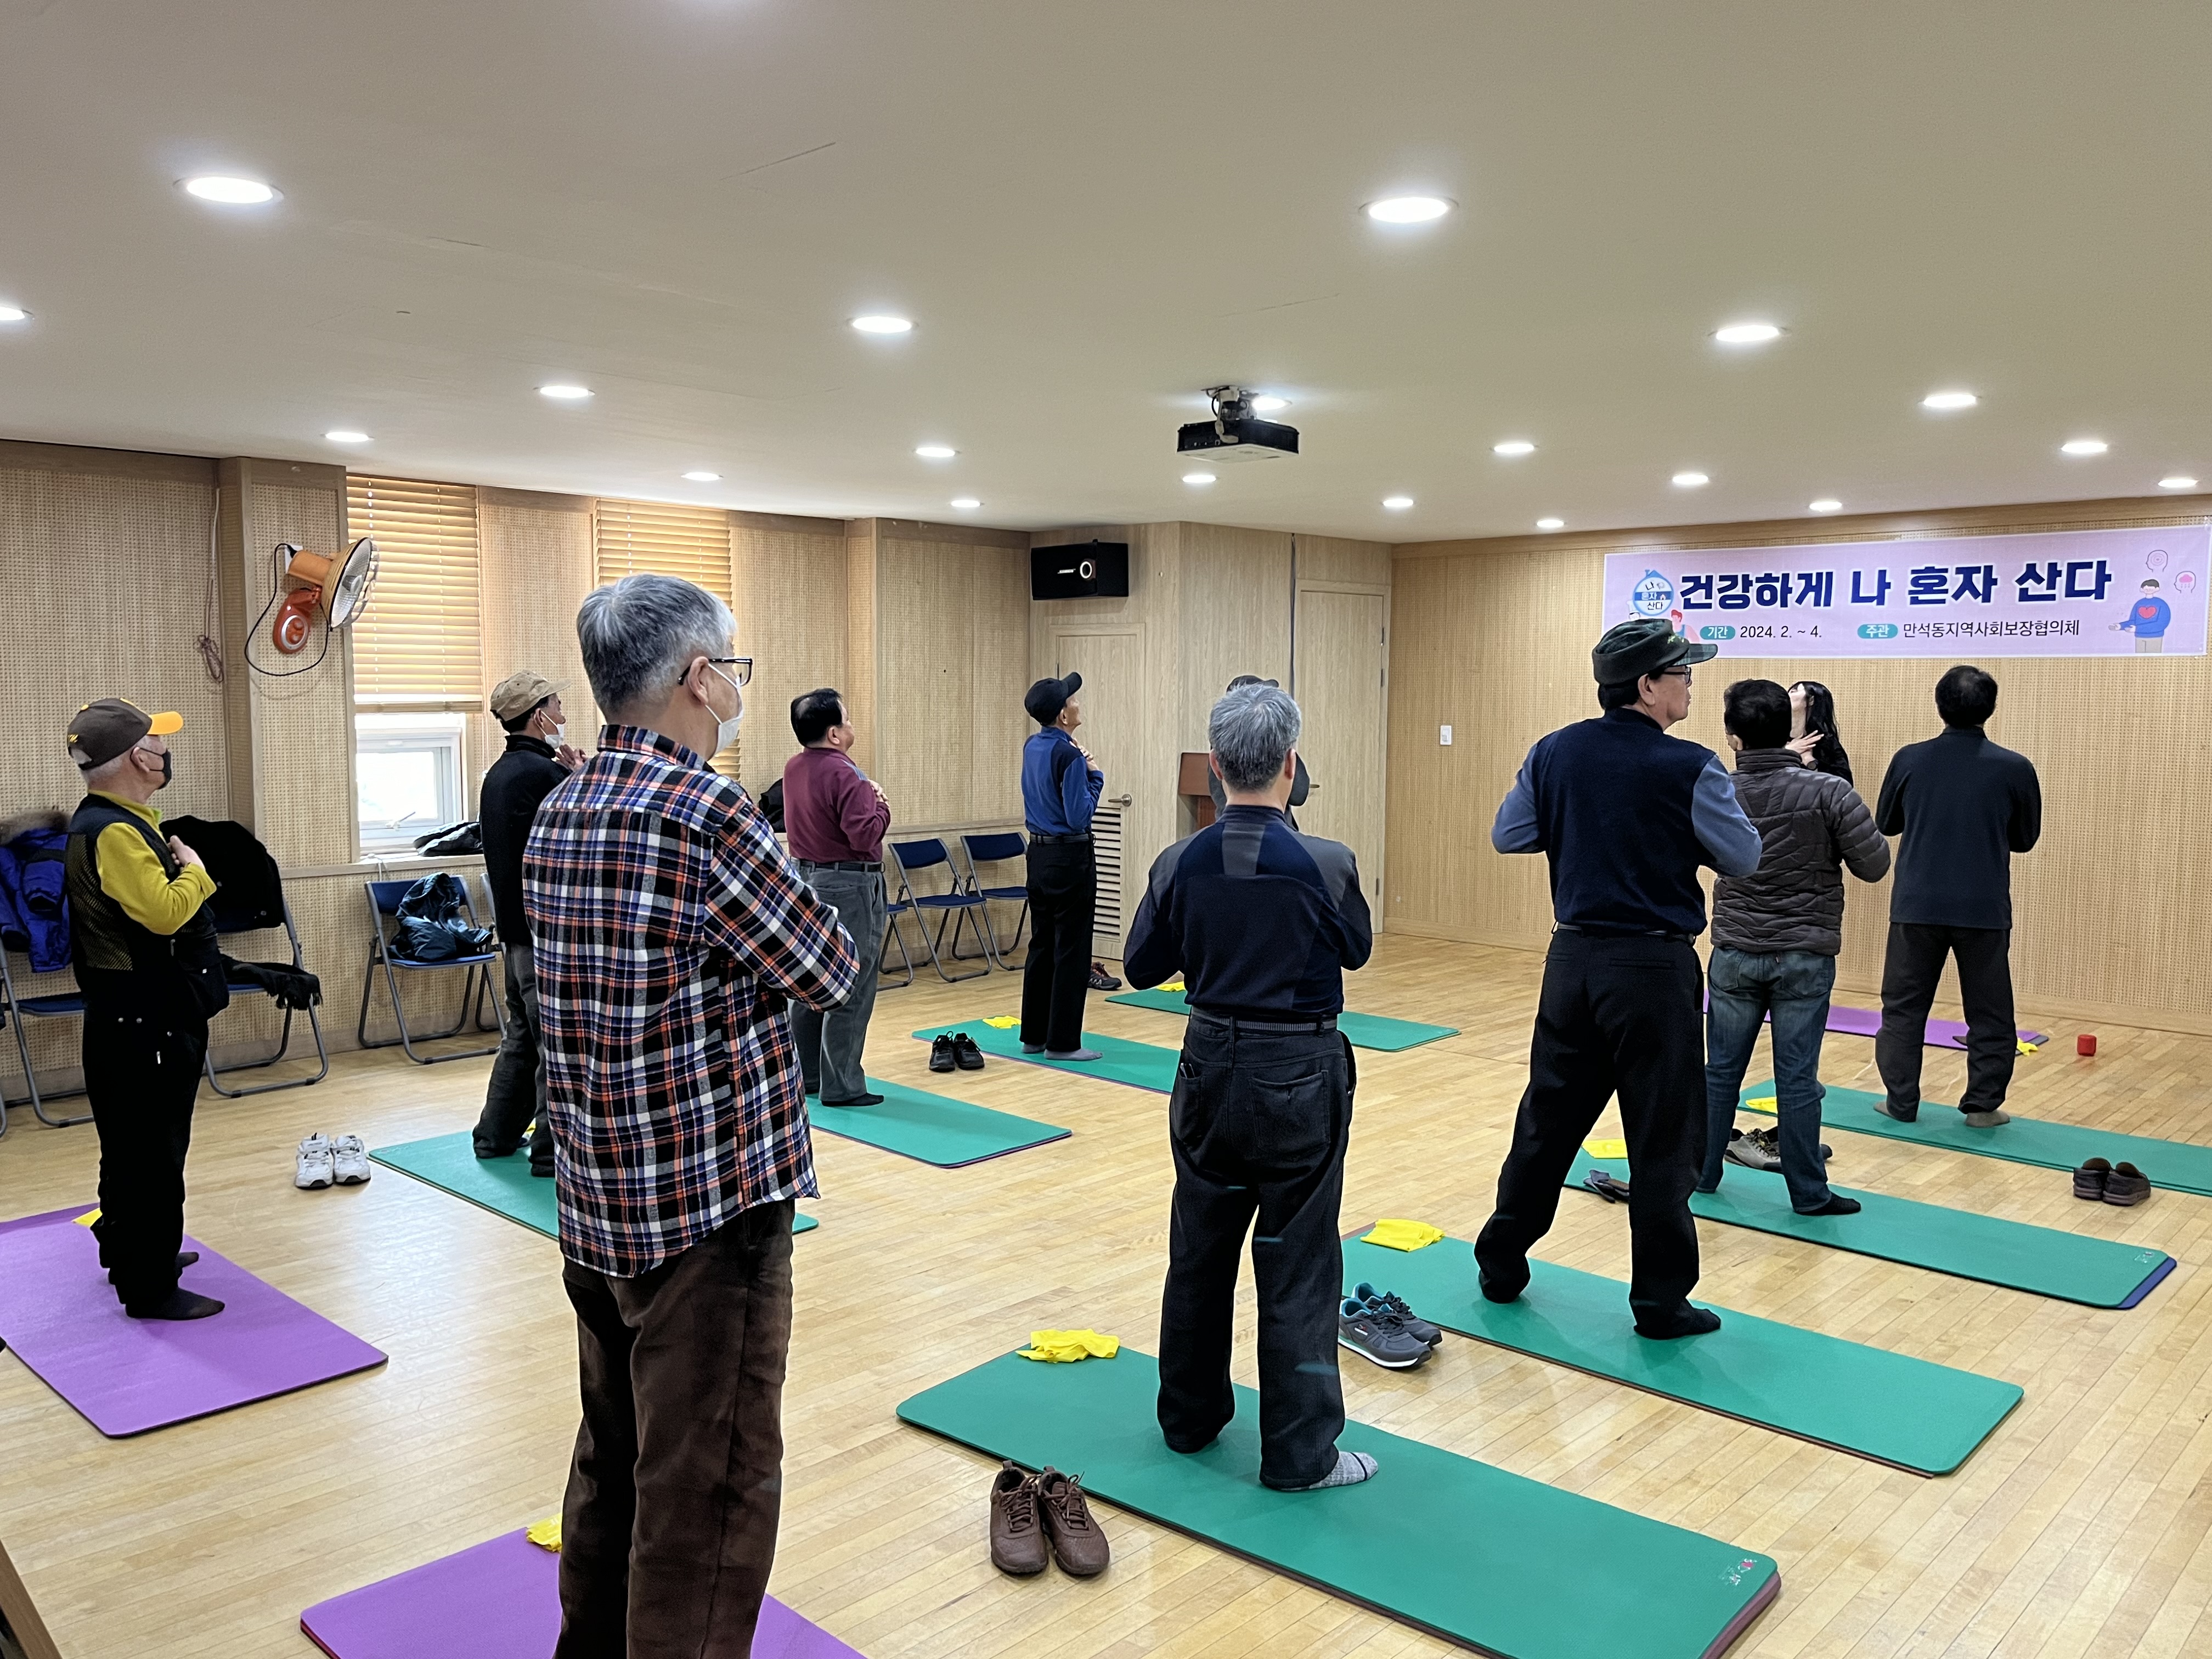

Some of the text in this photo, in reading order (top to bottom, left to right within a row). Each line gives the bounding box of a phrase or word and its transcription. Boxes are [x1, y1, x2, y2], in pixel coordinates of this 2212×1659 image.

[1645, 582, 1655, 590] 나
[1680, 560, 2112, 610] 건강하게 나 혼자 산다
[1647, 602, 1663, 611] 산다
[1707, 626, 1728, 639] 기간
[1740, 626, 1776, 639] 2024.
[1780, 626, 1792, 638] 2.
[1810, 625, 1822, 638] 4.
[1865, 619, 2080, 639] 주관 만석동지역사회보장협의체
